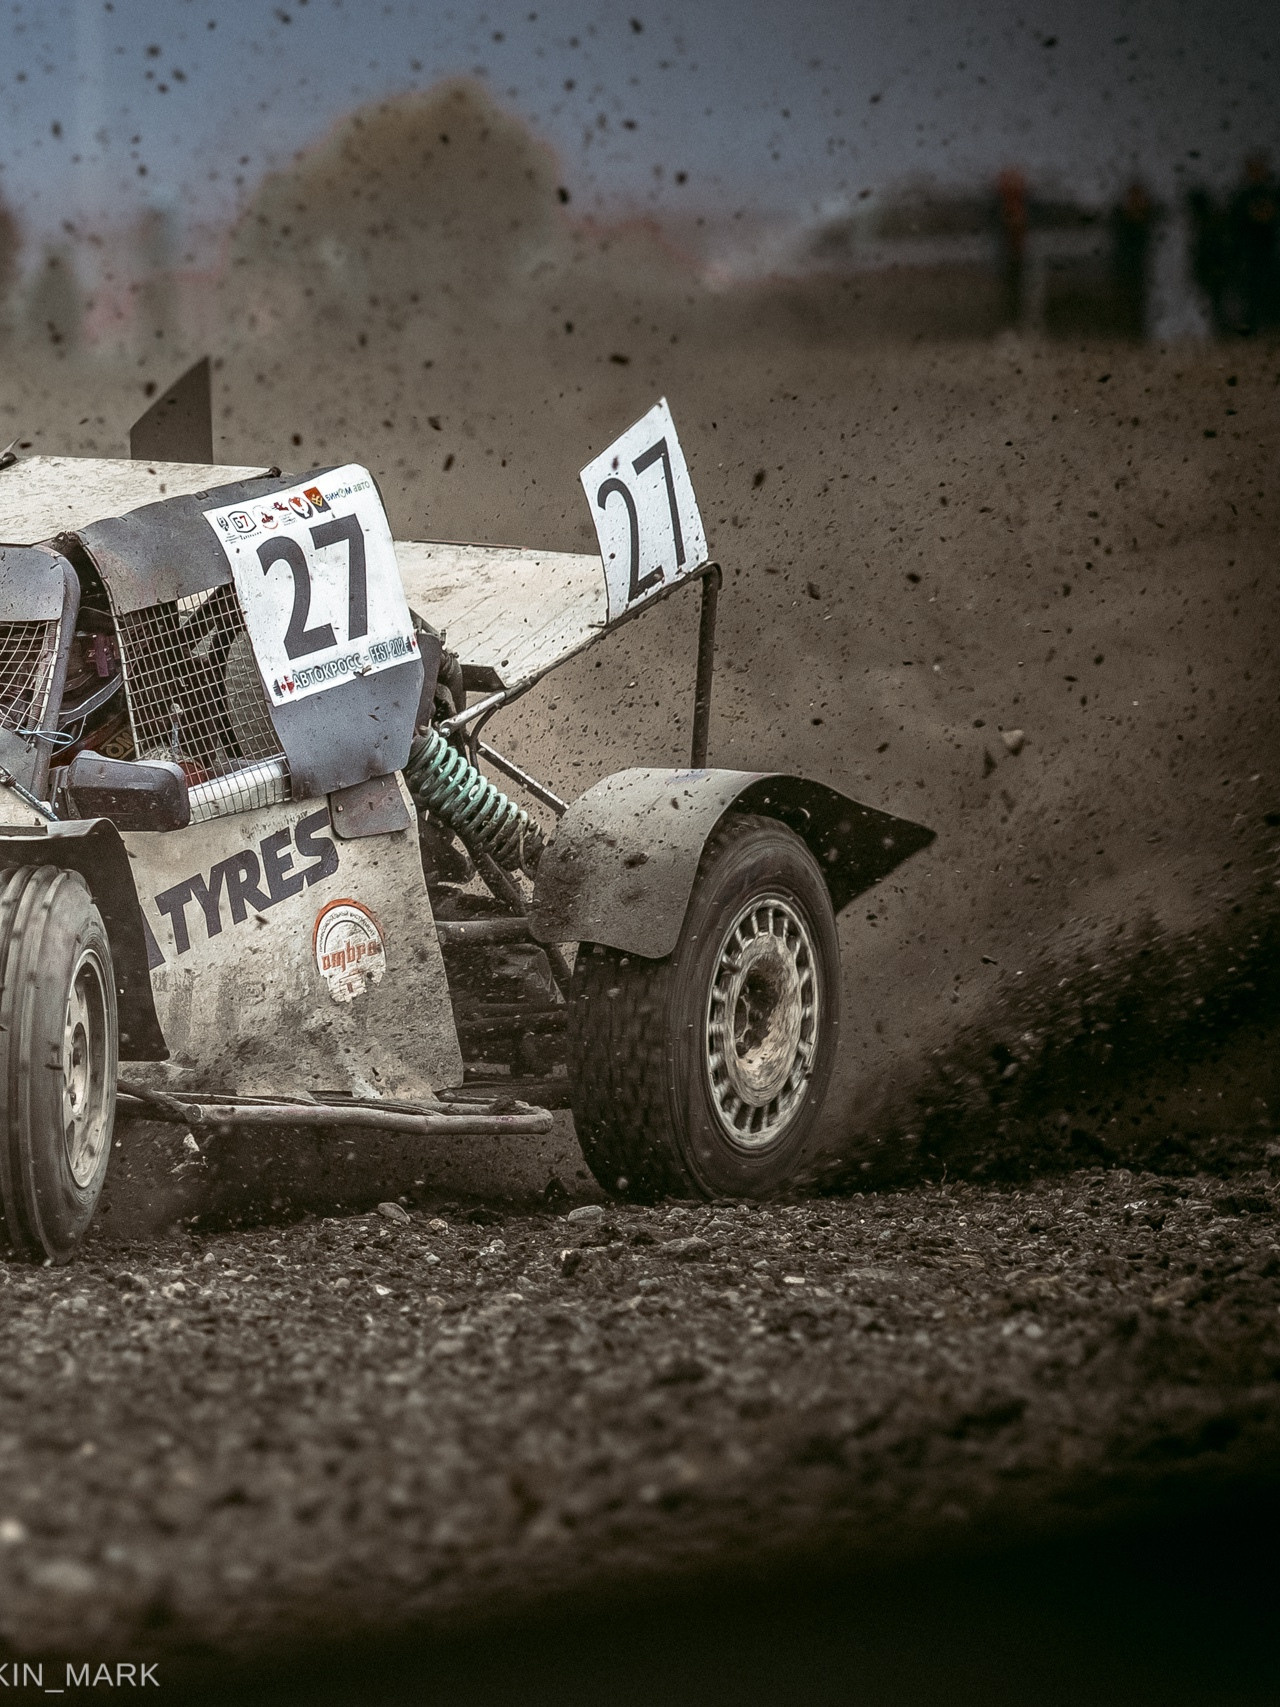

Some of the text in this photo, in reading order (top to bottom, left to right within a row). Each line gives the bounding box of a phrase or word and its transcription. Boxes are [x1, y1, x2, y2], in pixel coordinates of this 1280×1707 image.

[597, 436, 686, 602] 27
[256, 513, 368, 661] 27
[292, 653, 363, 690] АВТОКРОСС
[106, 732, 134, 758] OM
